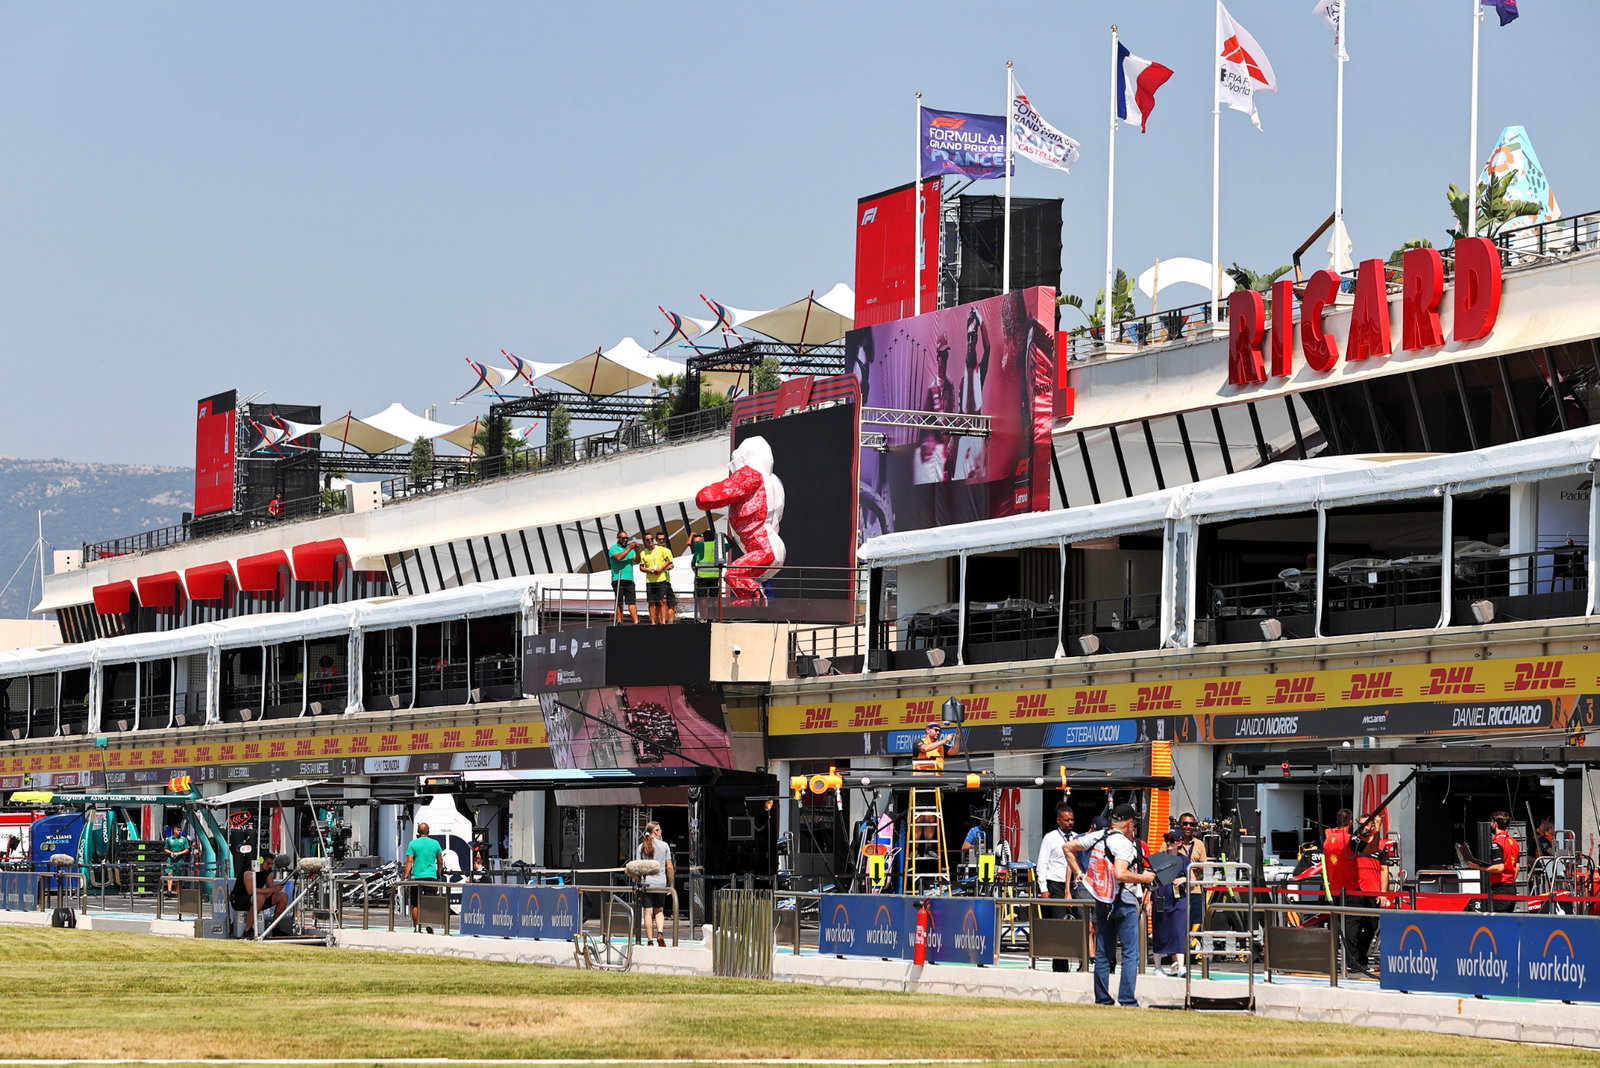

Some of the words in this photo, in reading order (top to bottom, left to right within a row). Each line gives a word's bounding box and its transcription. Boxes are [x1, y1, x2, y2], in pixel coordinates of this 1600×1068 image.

[1014, 114, 1040, 132] RAND
[929, 127, 997, 145] FORMULA
[999, 134, 1004, 145] 1
[929, 139, 962, 151] GRAND
[963, 143, 988, 153] PRIX
[989, 145, 1004, 153] DE
[1228, 236, 1504, 386] RICARD
[1349, 671, 1394, 700] DHL
[1429, 666, 1476, 696] DHL
[1513, 660, 1567, 692] DHL
[1136, 685, 1174, 711] DHL
[1203, 681, 1243, 707] DHL
[1273, 676, 1317, 705] DHL
[1015, 693, 1049, 718] DHL
[1073, 689, 1110, 715] DHL
[1586, 698, 1594, 724] 3
[805, 708, 832, 730] DHL
[853, 704, 882, 727] DHL
[905, 700, 935, 724] DHL
[1452, 708, 1486, 727] DANIEL
[1487, 705, 1542, 726] RICCIARDO
[507, 726, 529, 744] DHL
[1066, 727, 1099, 743] ESTEBAN
[1098, 725, 1120, 741] OCON
[1181, 716, 1189, 741] 4
[1235, 717, 1265, 736] LANDO
[1265, 716, 1299, 735] NORRIS
[324, 739, 339, 754] DHL
[352, 737, 367, 752] DHL
[381, 735, 398, 751] DHL
[411, 733, 429, 750] DHL
[442, 731, 460, 748] DHL
[474, 729, 494, 746] DHL
[195, 747, 210, 762] DHL
[219, 745, 234, 760] DHL
[244, 744, 259, 758] DHL
[270, 742, 285, 757] DHL
[297, 740, 312, 755] DHL
[477, 755, 491, 767] GASLY
[908, 928, 942, 953] wday.
